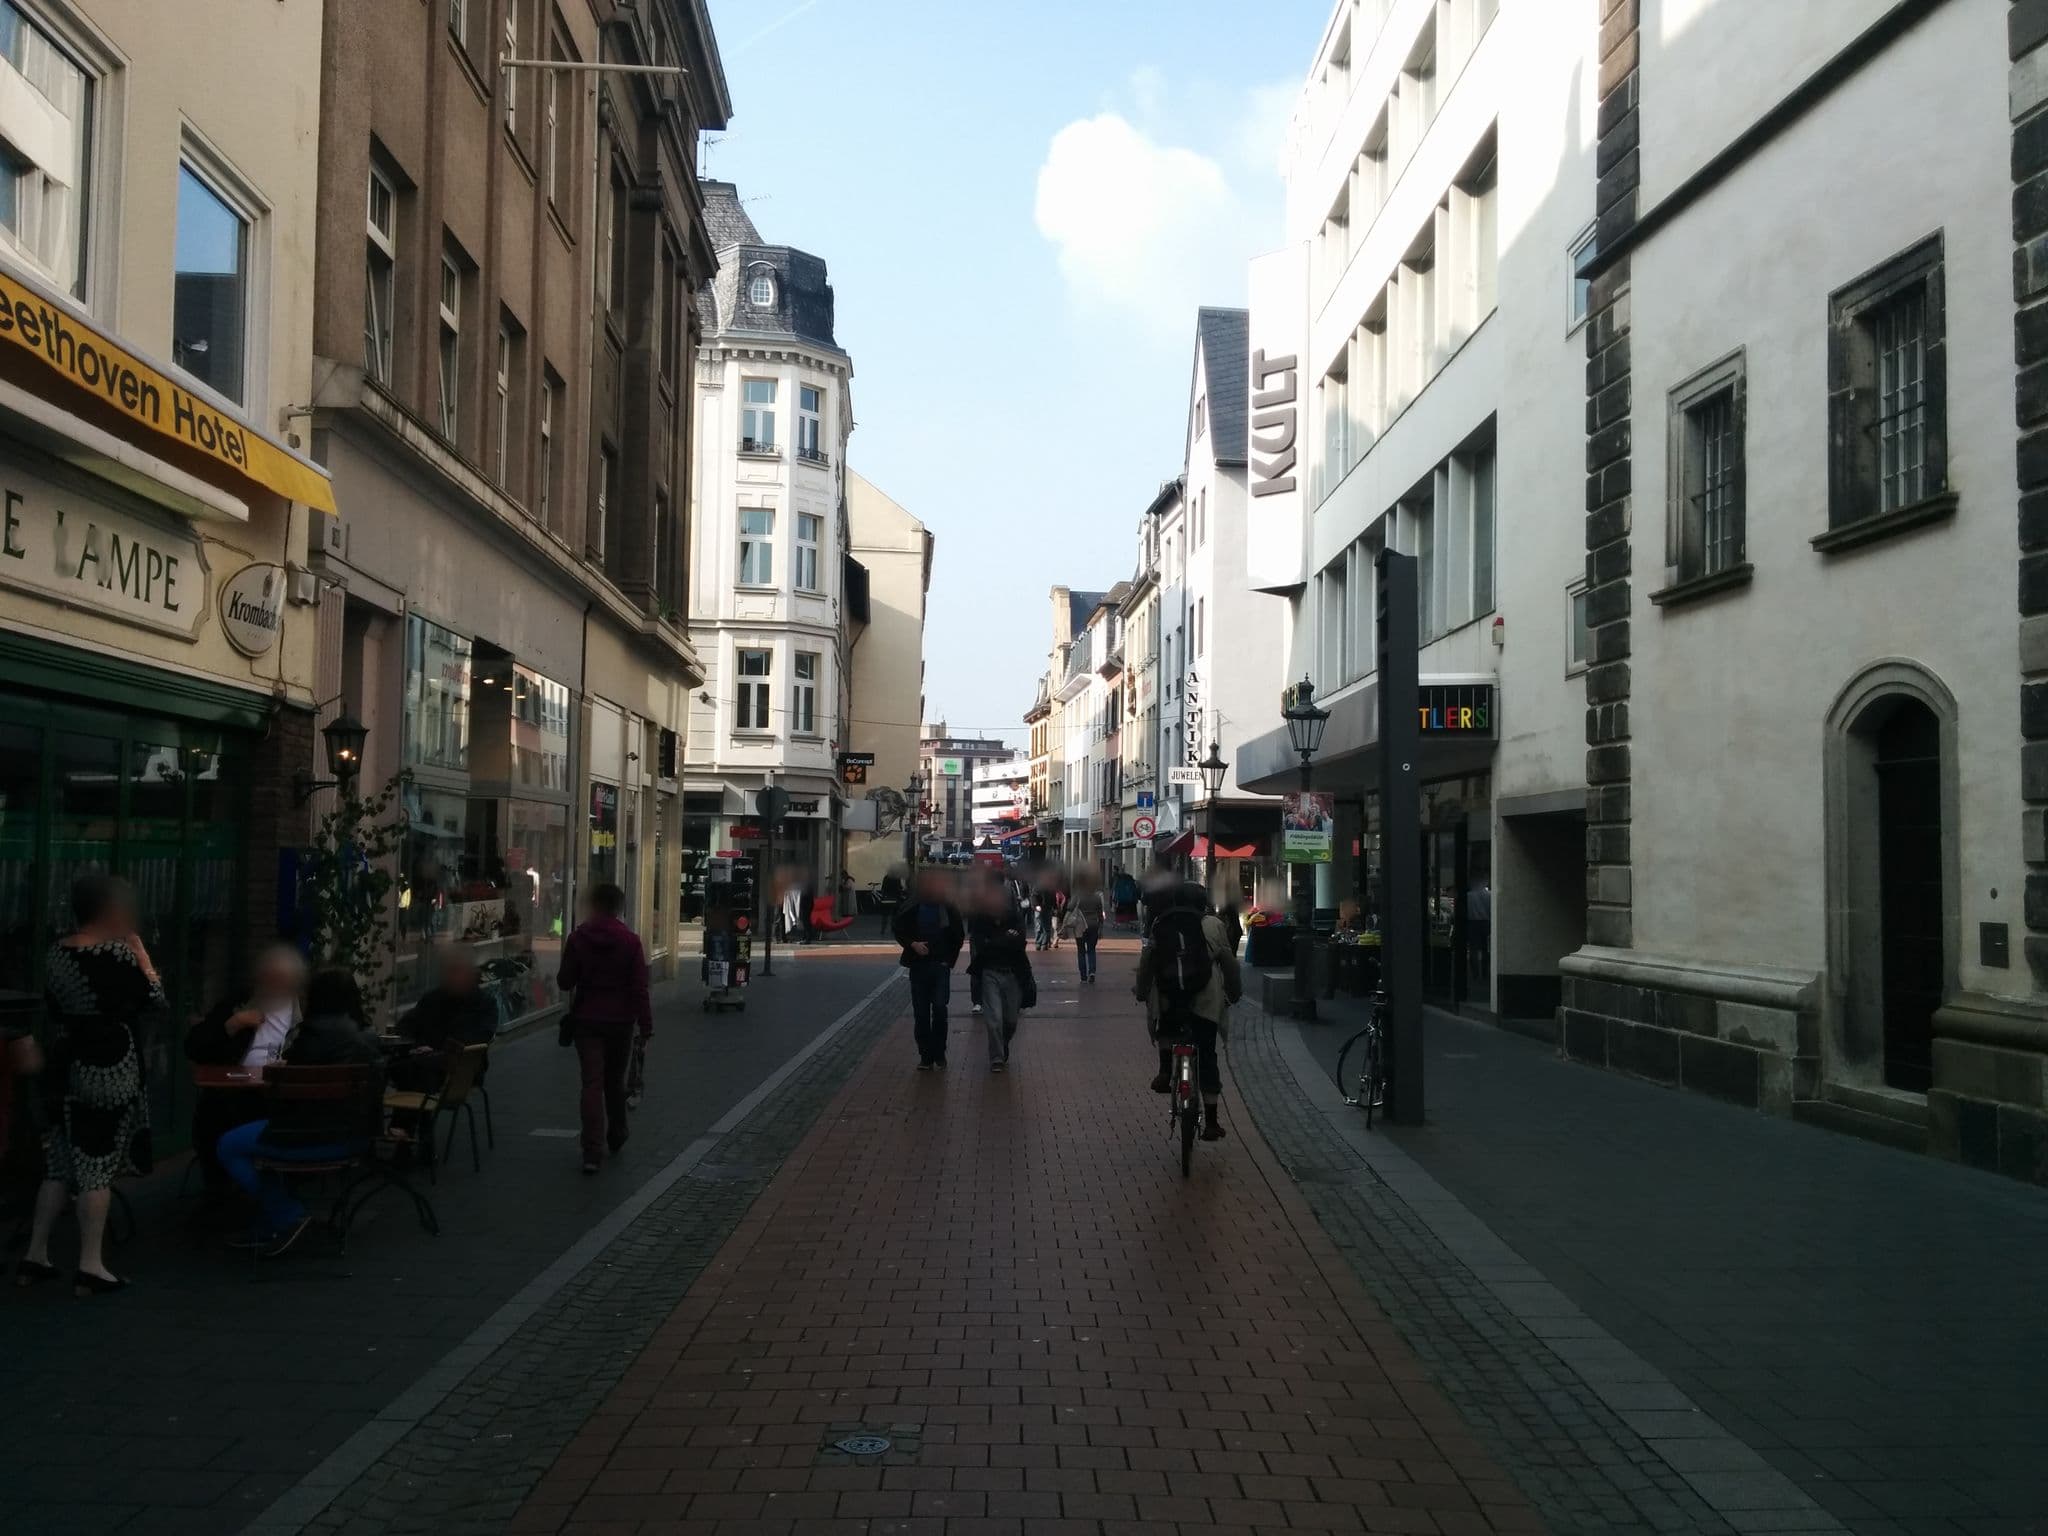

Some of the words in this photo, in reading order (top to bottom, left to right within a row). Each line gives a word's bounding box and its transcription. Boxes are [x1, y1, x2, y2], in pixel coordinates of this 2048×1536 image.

[173, 388, 249, 470] Hotel
[1251, 348, 1298, 498] KULT
[1187, 671, 1200, 762] ANTIK
[1418, 706, 1487, 729] TLERS
